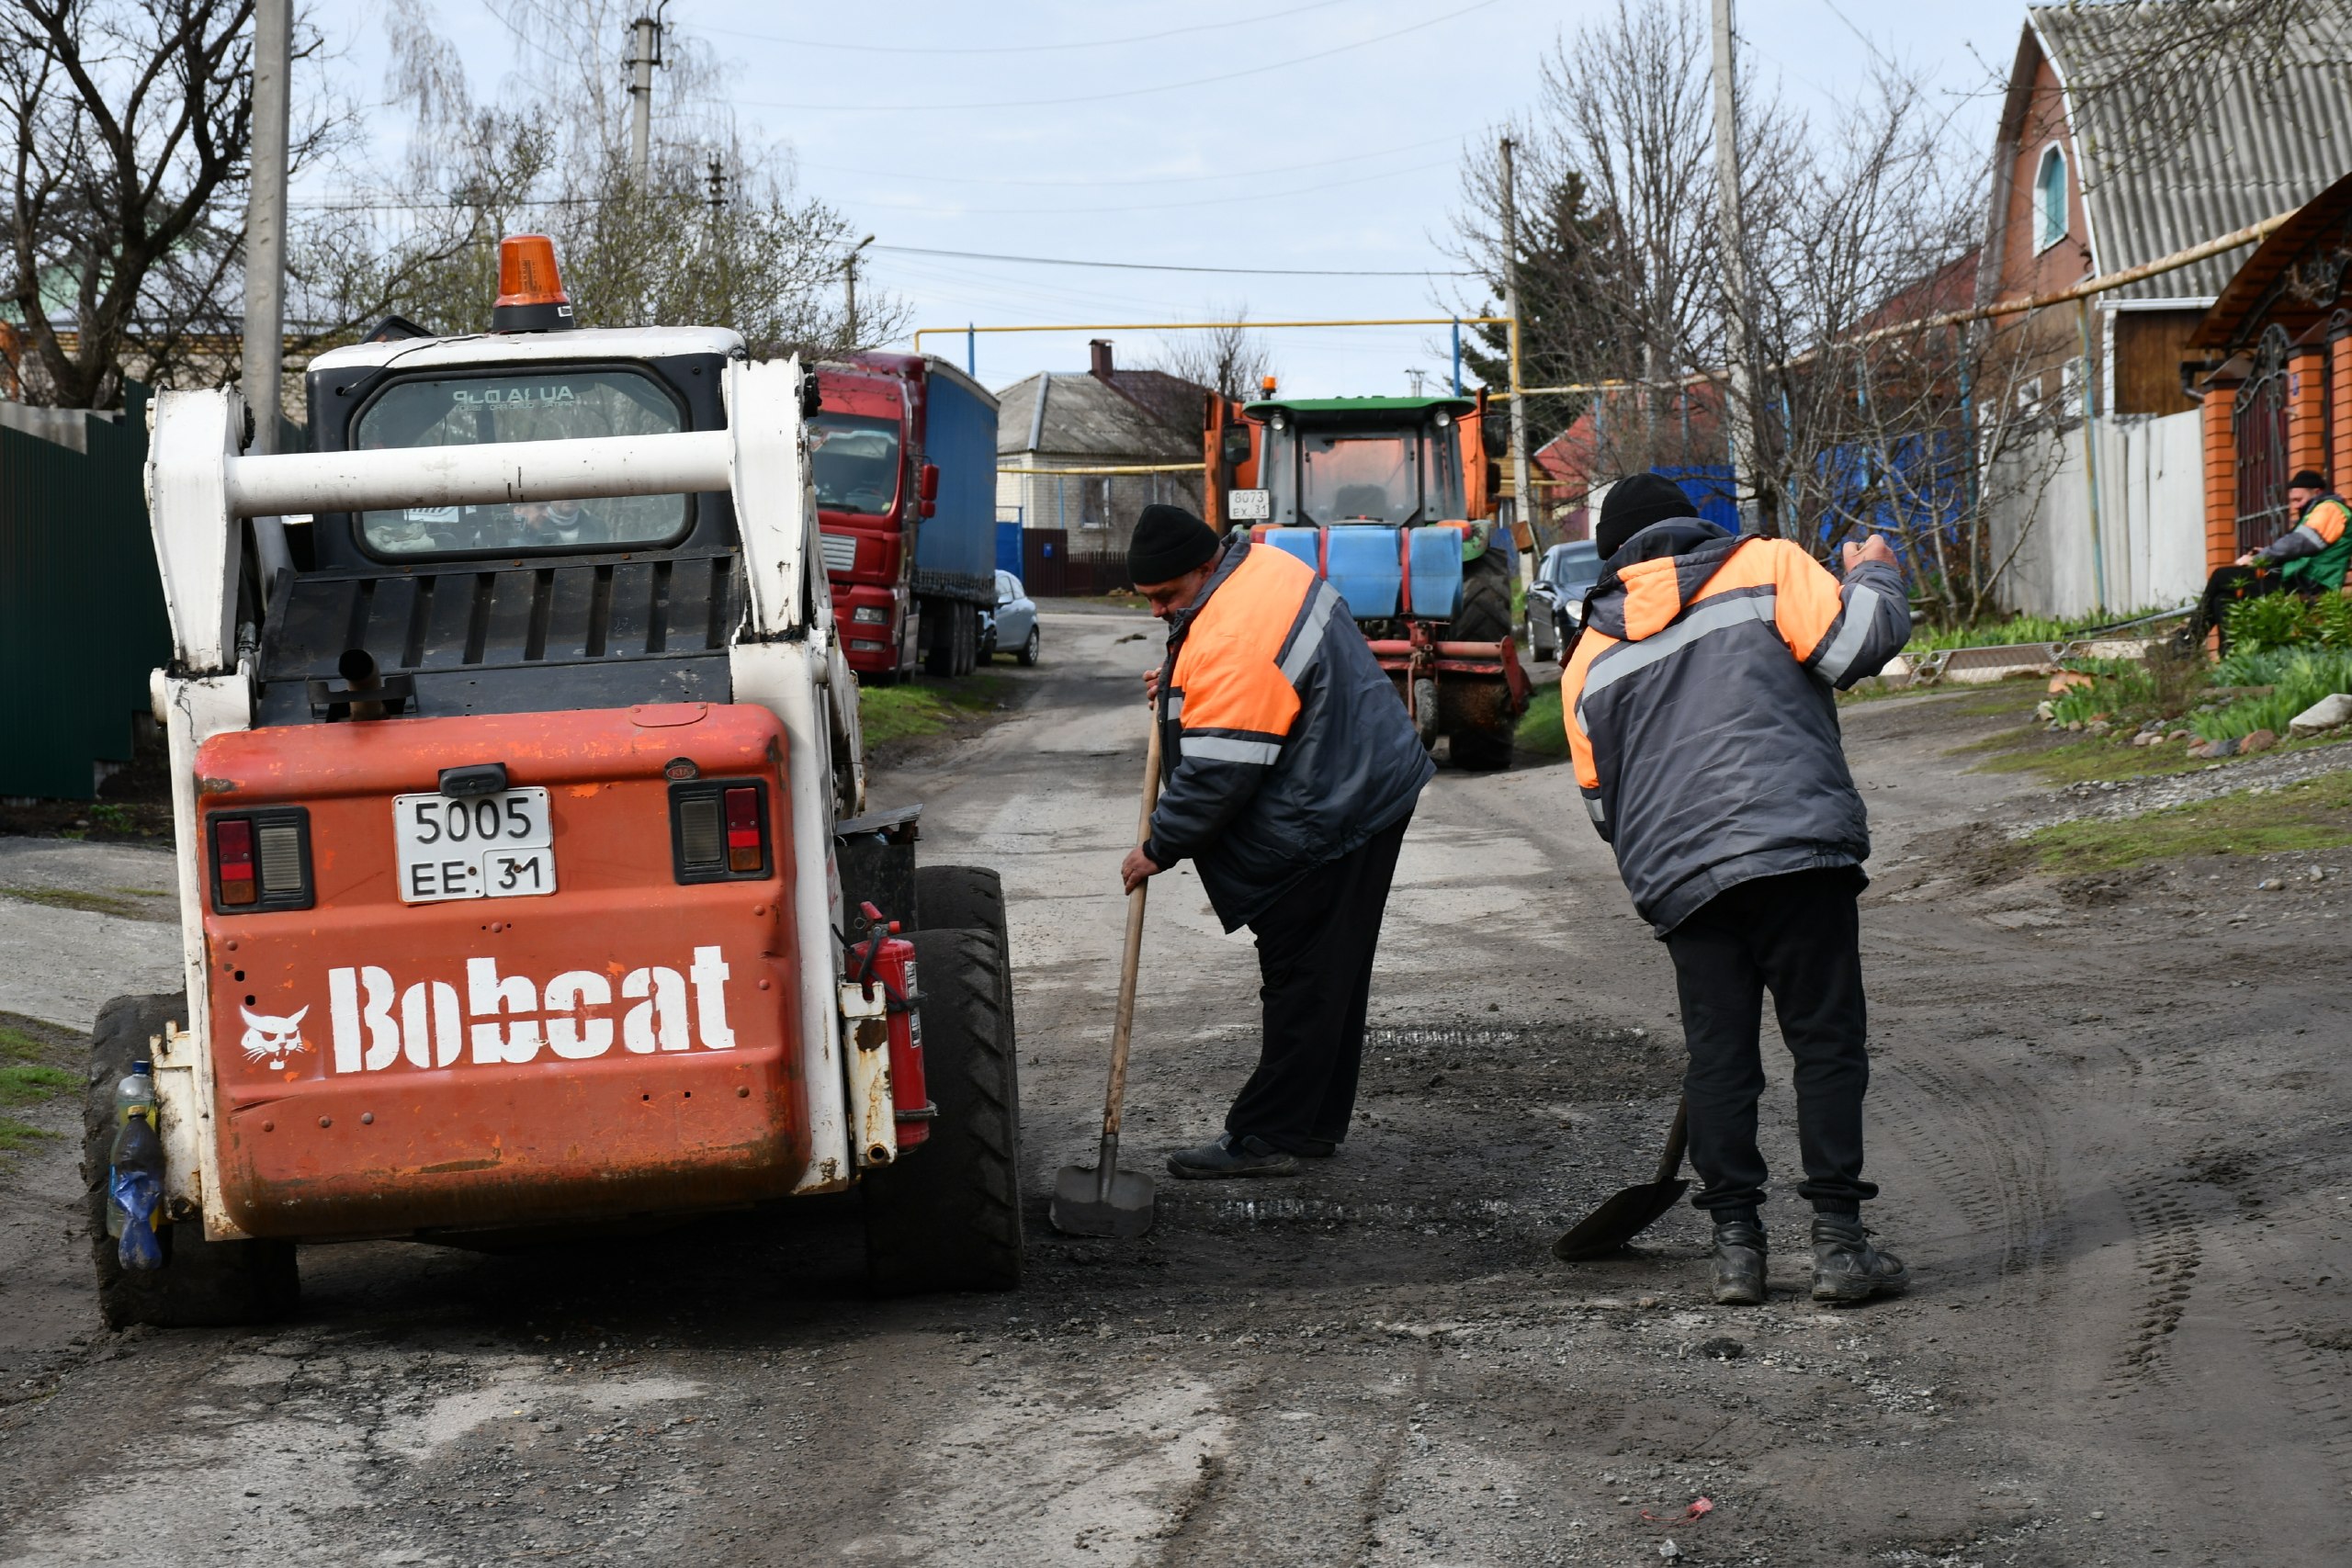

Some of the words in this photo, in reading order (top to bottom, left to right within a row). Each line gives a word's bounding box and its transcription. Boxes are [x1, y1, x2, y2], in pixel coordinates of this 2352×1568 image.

[1235, 491, 1264, 503] 8073
[1255, 504, 1267, 514] 31
[415, 796, 532, 844] 5005
[411, 860, 467, 897] EE
[497, 856, 540, 890] 31
[328, 945, 736, 1074] Bobcat
